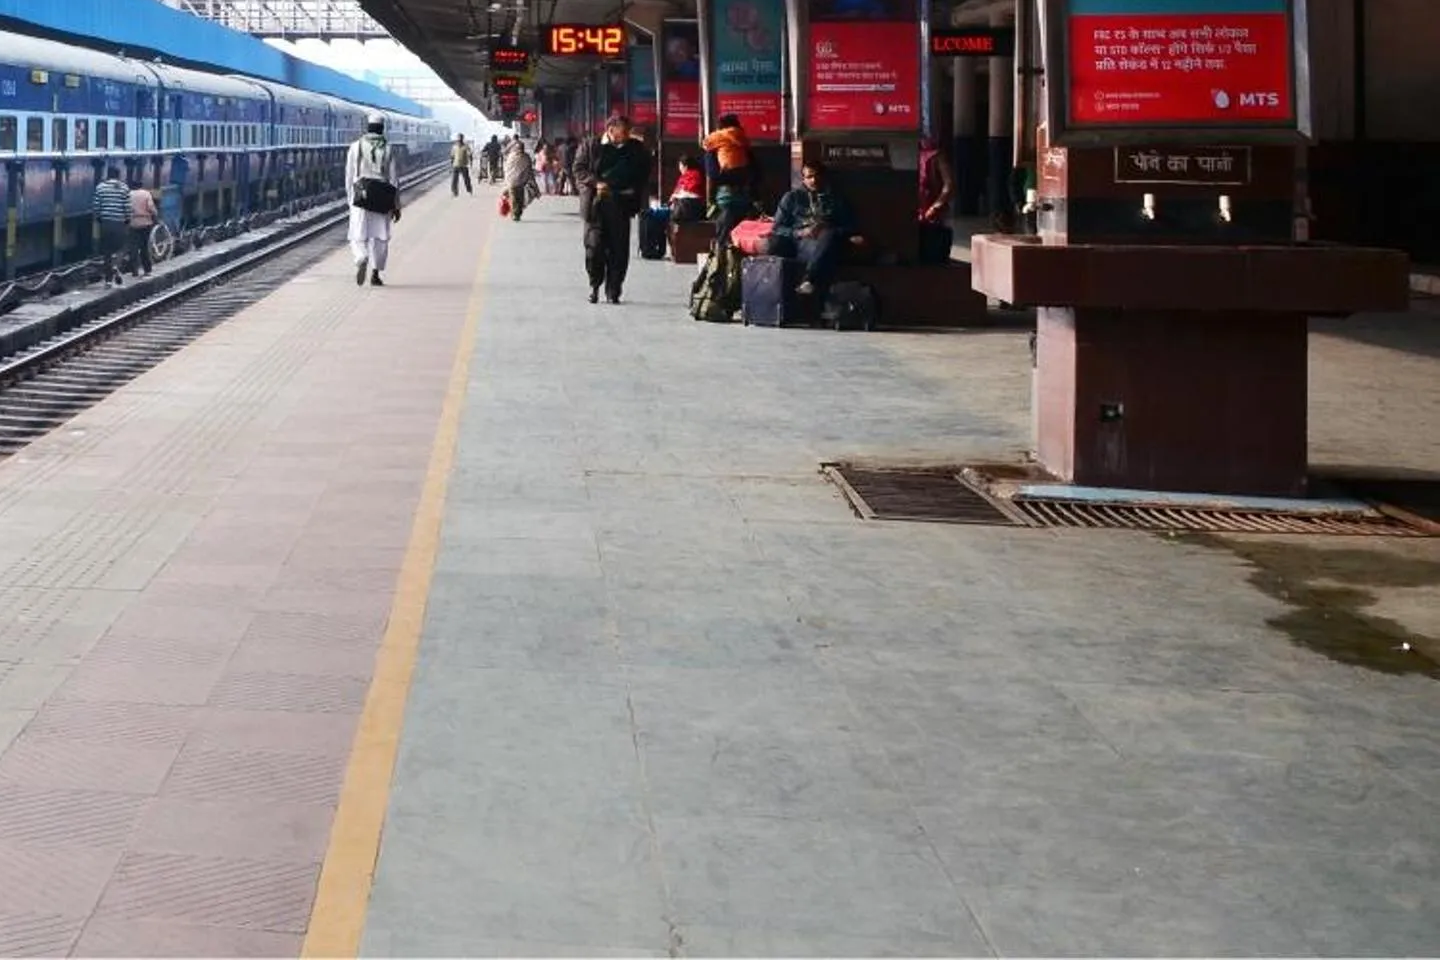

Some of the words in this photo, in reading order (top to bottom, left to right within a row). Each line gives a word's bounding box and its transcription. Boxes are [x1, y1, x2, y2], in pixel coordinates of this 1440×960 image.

[551, 28, 622, 54] 15:42
[933, 35, 994, 52] LCOME
[1239, 93, 1279, 107] MTS
